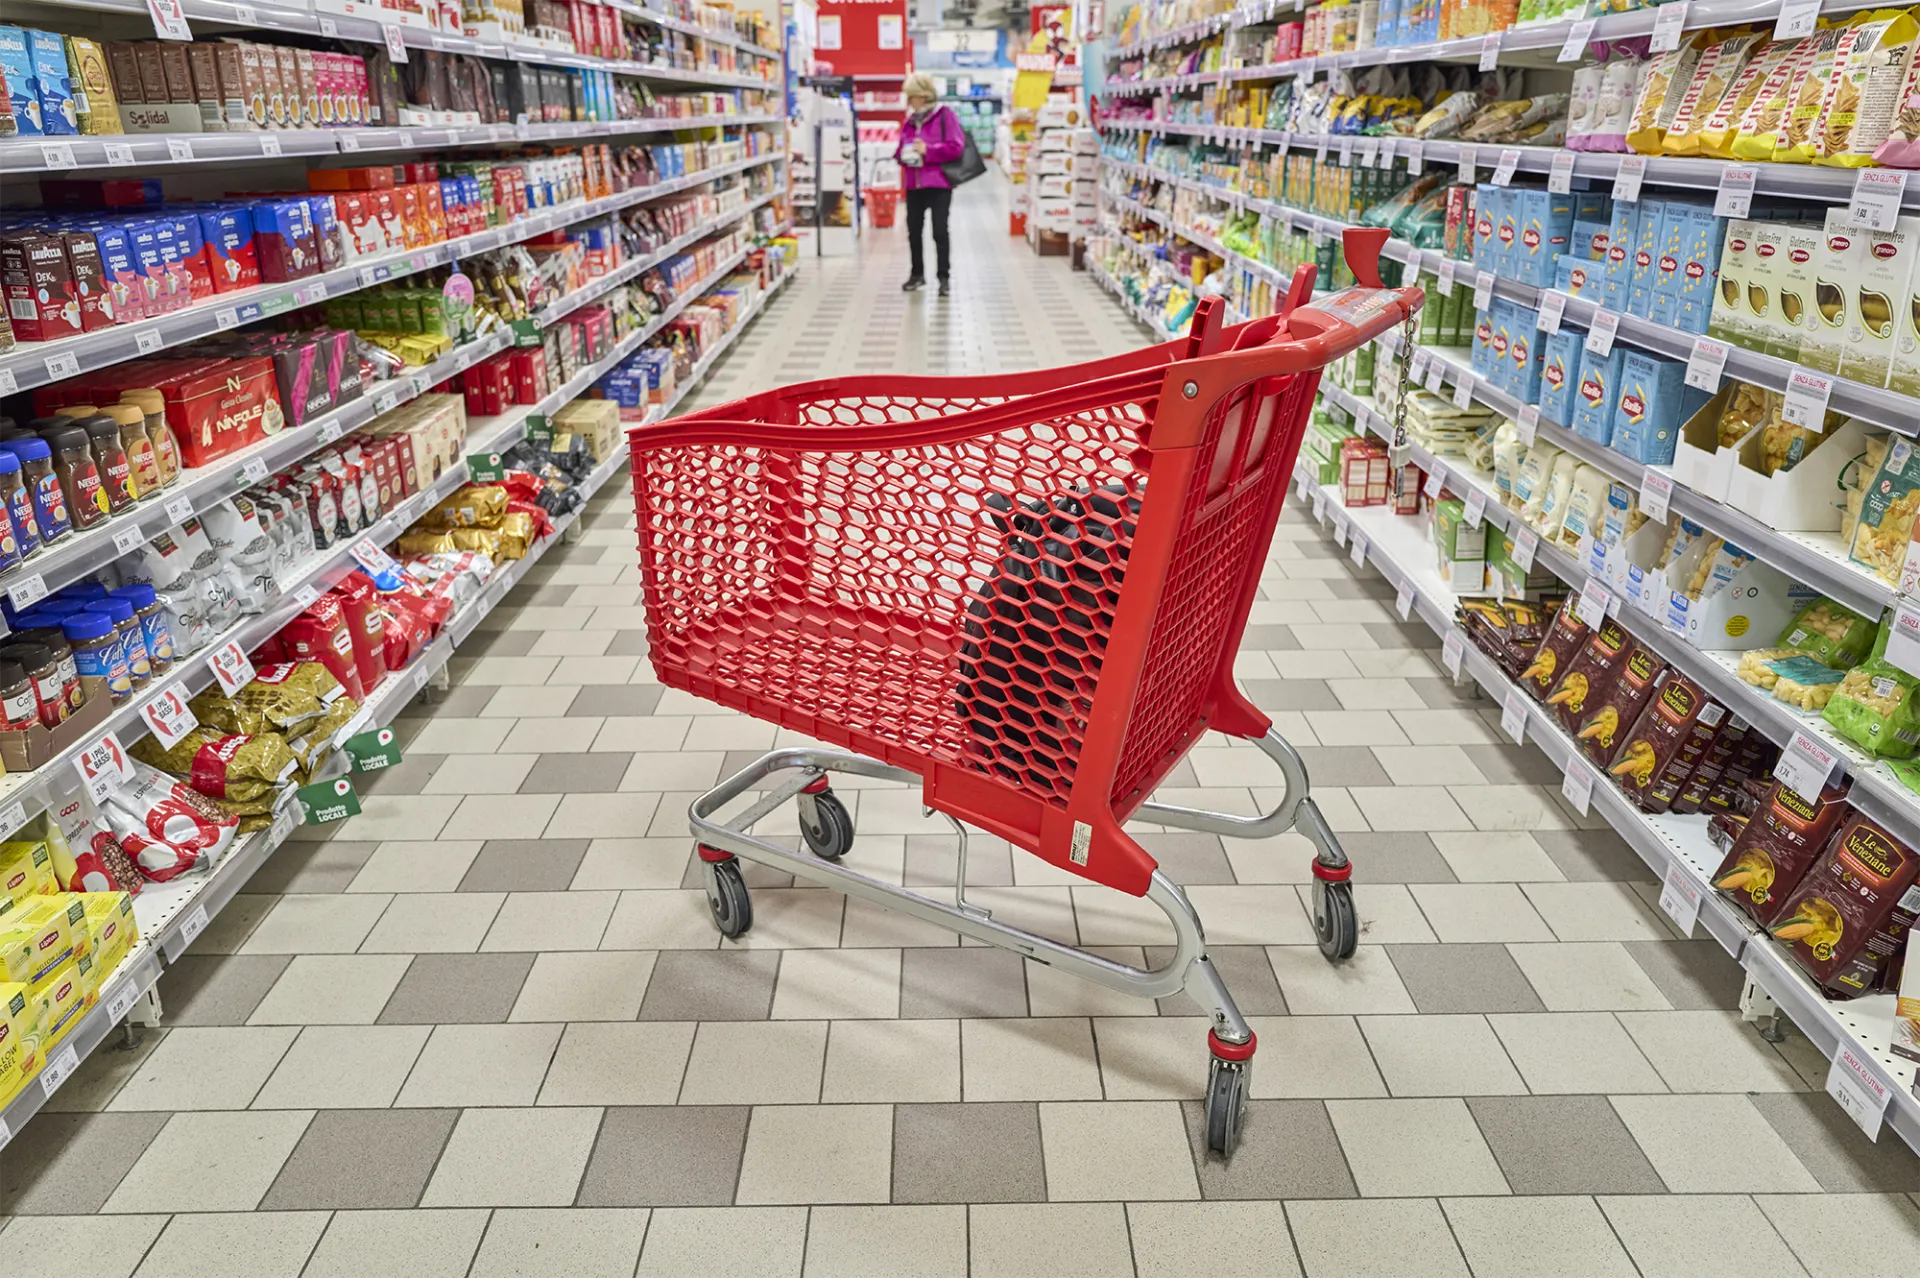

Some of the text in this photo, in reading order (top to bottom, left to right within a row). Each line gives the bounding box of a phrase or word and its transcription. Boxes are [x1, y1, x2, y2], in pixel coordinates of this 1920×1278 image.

[129, 111, 170, 125] Solidal
[1863, 172, 1902, 185] SENZA GLUTINE
[72, 240, 97, 255] LAVAZZA
[1830, 238, 1850, 250] granoro
[1874, 246, 1896, 257] granoro
[31, 245, 63, 261] LAVAZZA
[1791, 251, 1810, 262] granoro
[226, 375, 241, 392] N
[1794, 374, 1827, 391] SENZA GLUTINE
[1622, 398, 1644, 414] Barilla
[1716, 564, 1731, 575] SENZA
[1901, 614, 1919, 630] SENZA
[1663, 688, 1689, 716] Veneziane
[158, 705, 174, 719] BASSI
[95, 746, 105, 760] PIÙ
[1796, 737, 1832, 765] SENZA GLUTINE
[94, 753, 111, 769] BASSI
[360, 753, 387, 766] Prodotto
[362, 760, 389, 772] LOCALE
[315, 804, 346, 817] Prodotto
[1778, 787, 1816, 820] Veneziane
[318, 810, 347, 823] LOCALE
[1862, 833, 1877, 849] Le
[1848, 835, 1891, 876] Veneziane
[8, 874, 25, 889] Lipton
[104, 923, 116, 939] Lipton
[40, 932, 58, 949] Lipton
[36, 945, 69, 972] YELLOW LABEL
[42, 953, 67, 976] DETEINATO
[56, 984, 72, 1000] Lipton
[1842, 1050, 1886, 1097] SENZA GLUTINE
